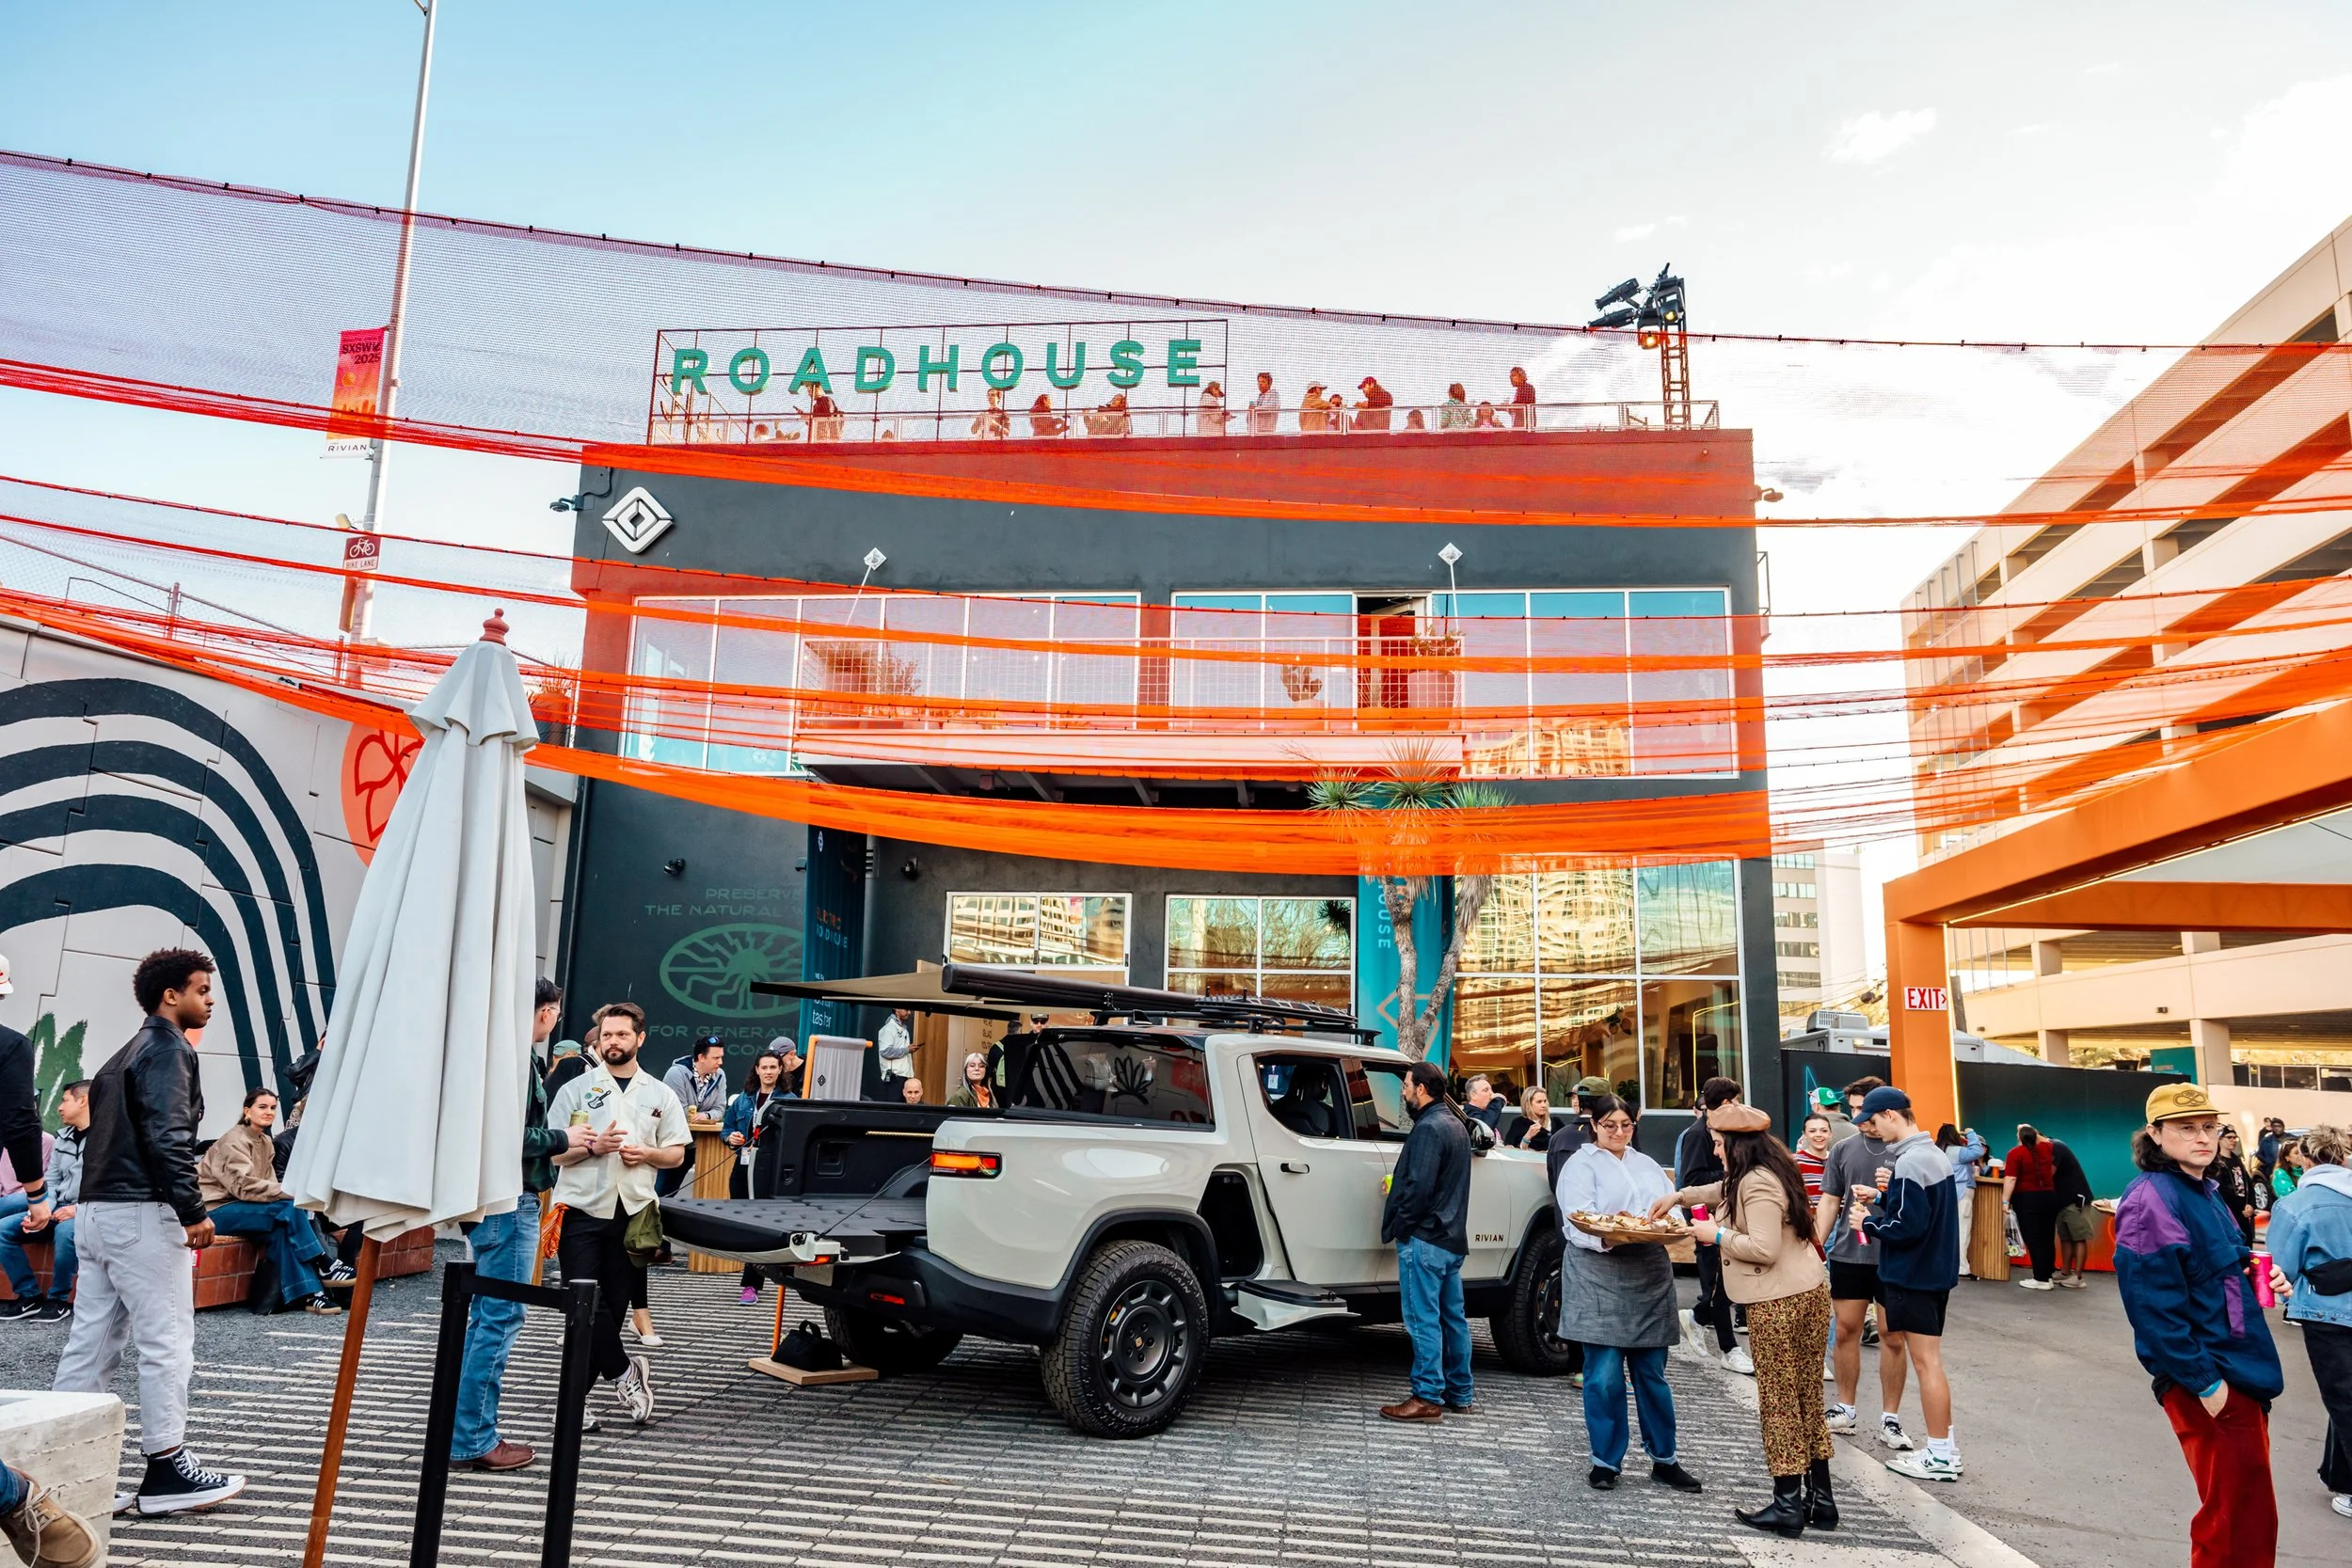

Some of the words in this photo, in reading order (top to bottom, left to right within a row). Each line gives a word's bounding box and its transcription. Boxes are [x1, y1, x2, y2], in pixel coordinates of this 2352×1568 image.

[354, 353, 381, 364] 2025
[672, 339, 1202, 396] ROADHOUSE
[360, 559, 375, 568] LANE
[706, 888, 803, 900] PRESERVE
[644, 904, 682, 915] THE
[689, 904, 783, 917] NATURAL
[1907, 988, 1941, 1008] EXIT
[649, 1025, 688, 1036] FOR
[696, 1026, 800, 1039] GENERATI
